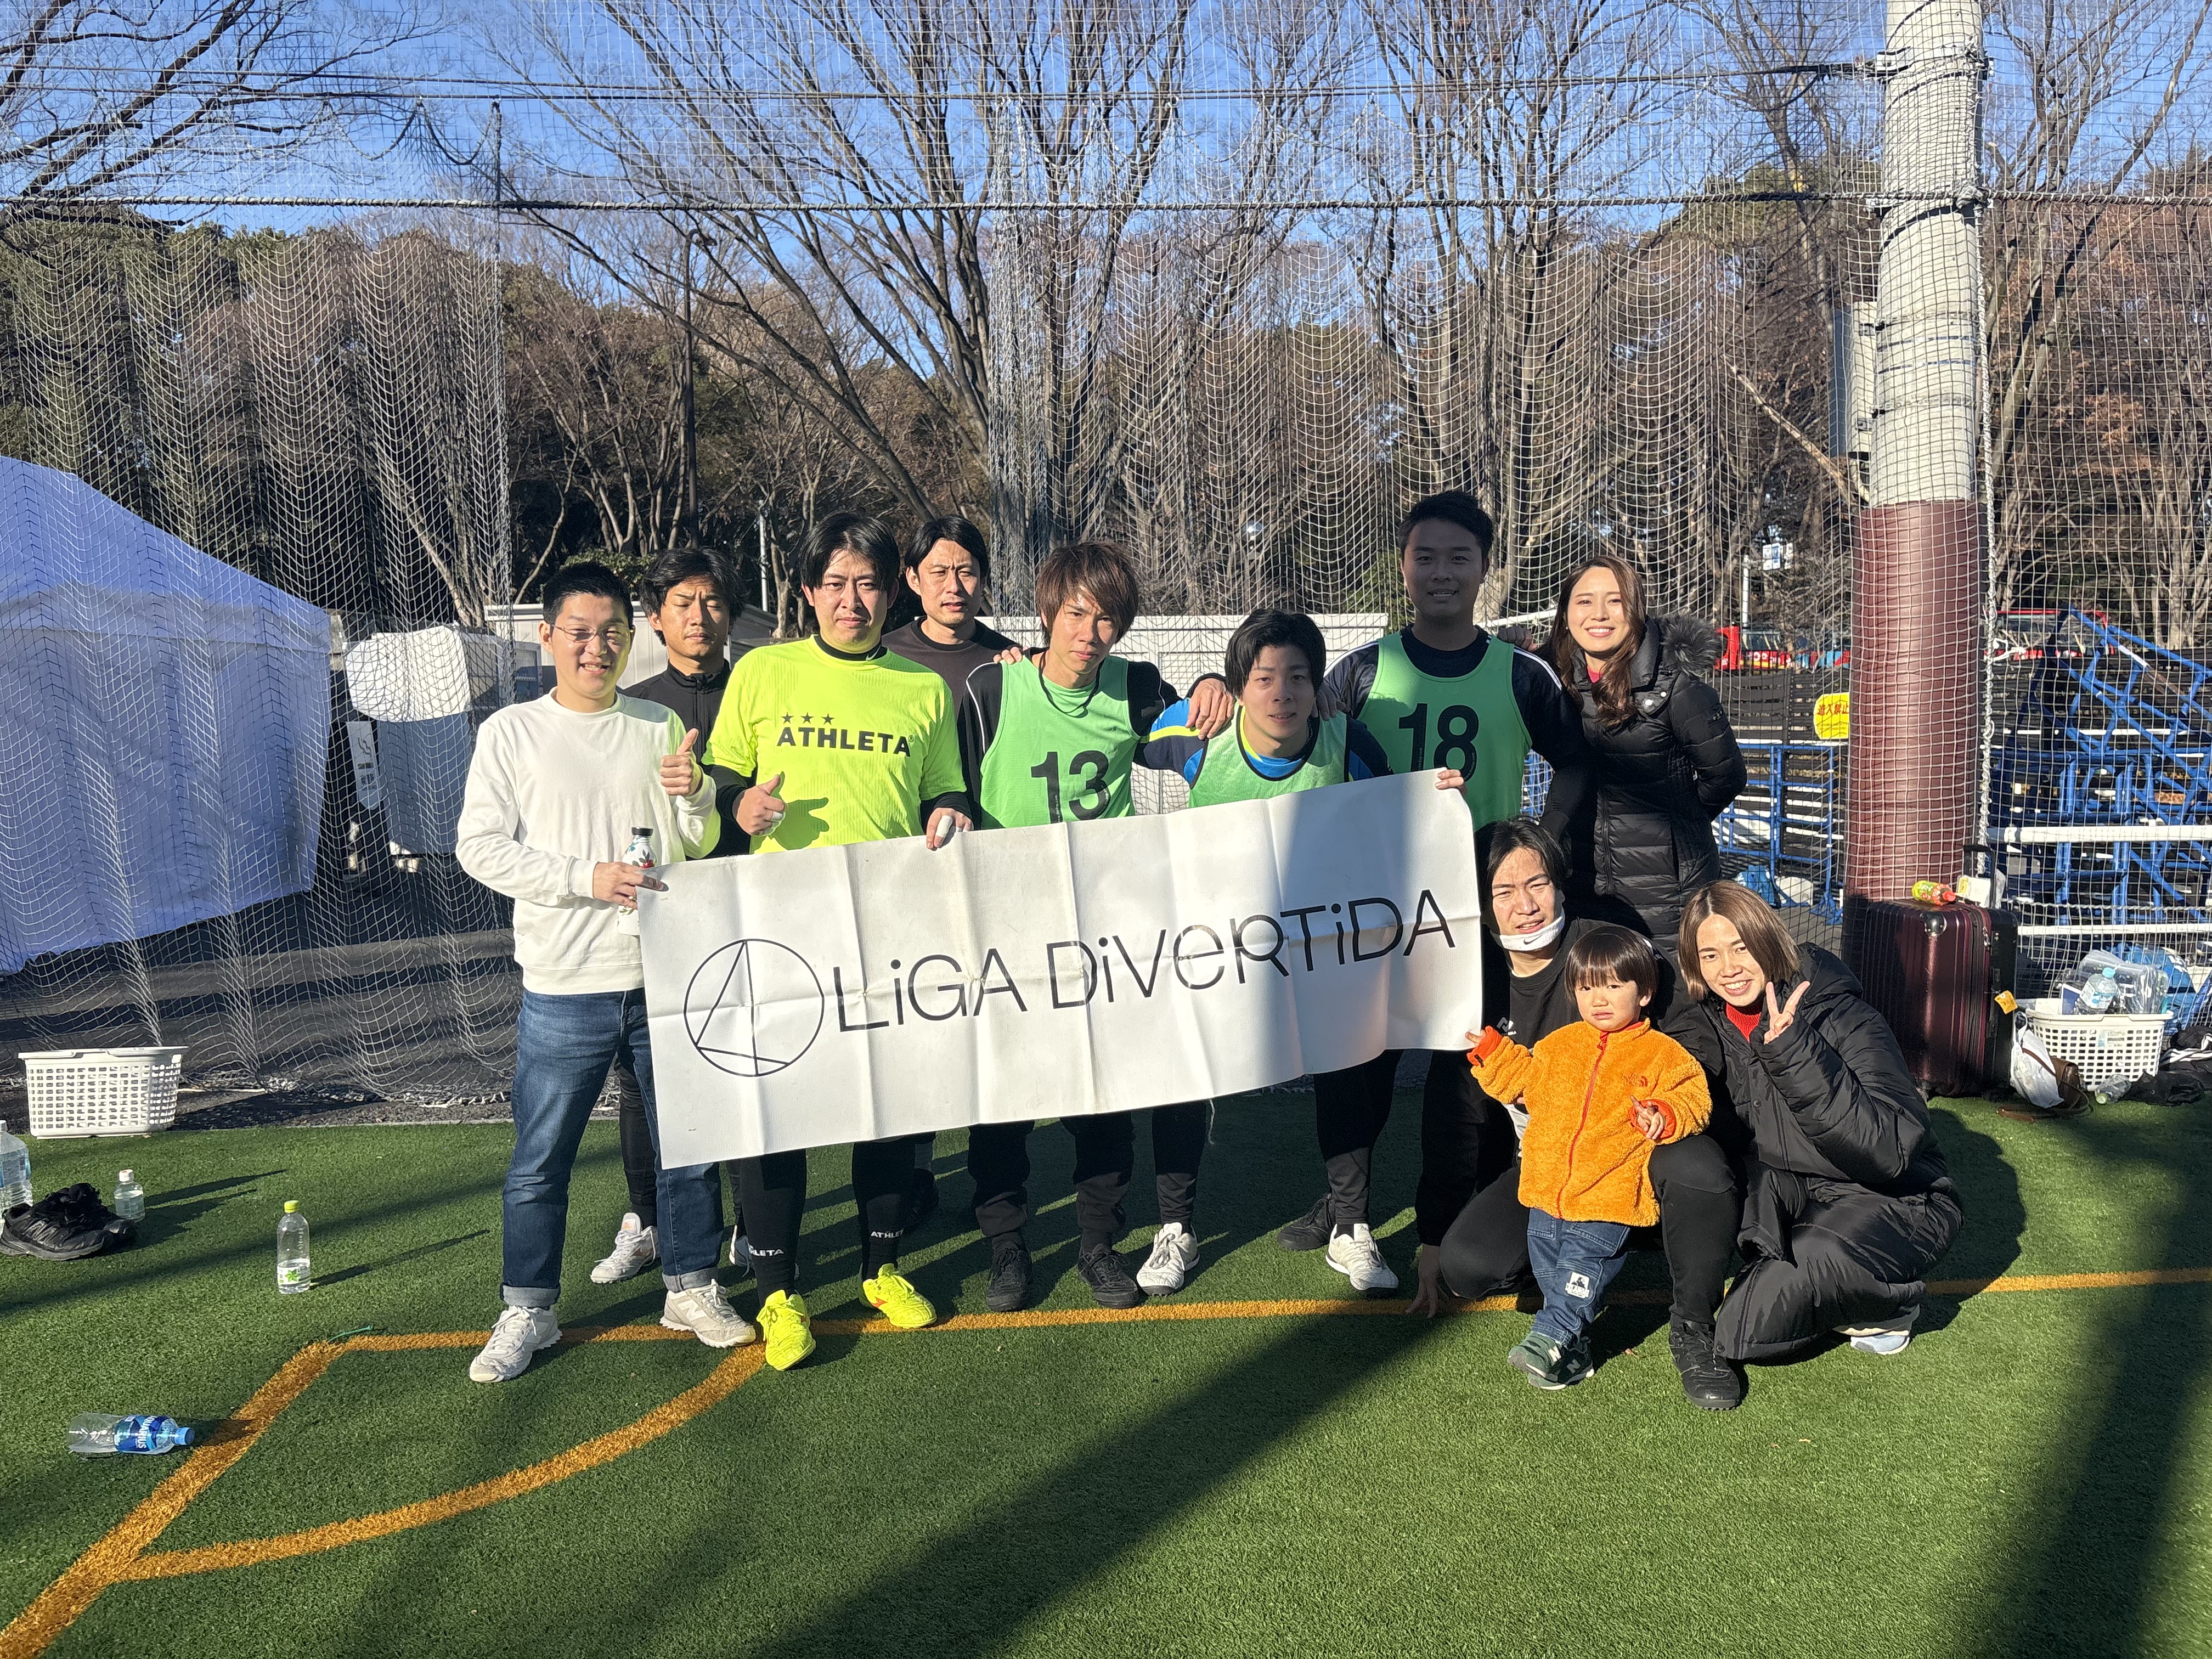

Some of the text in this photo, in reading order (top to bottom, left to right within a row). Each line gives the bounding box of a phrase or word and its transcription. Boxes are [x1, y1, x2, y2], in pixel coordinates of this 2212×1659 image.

[776, 726, 911, 758] ATHLETA
[1399, 703, 1479, 782] 18
[1030, 750, 1111, 824] 13
[833, 889, 1456, 1032] LiGA DiVeRTiDA
[871, 1228, 904, 1238] ATHLET
